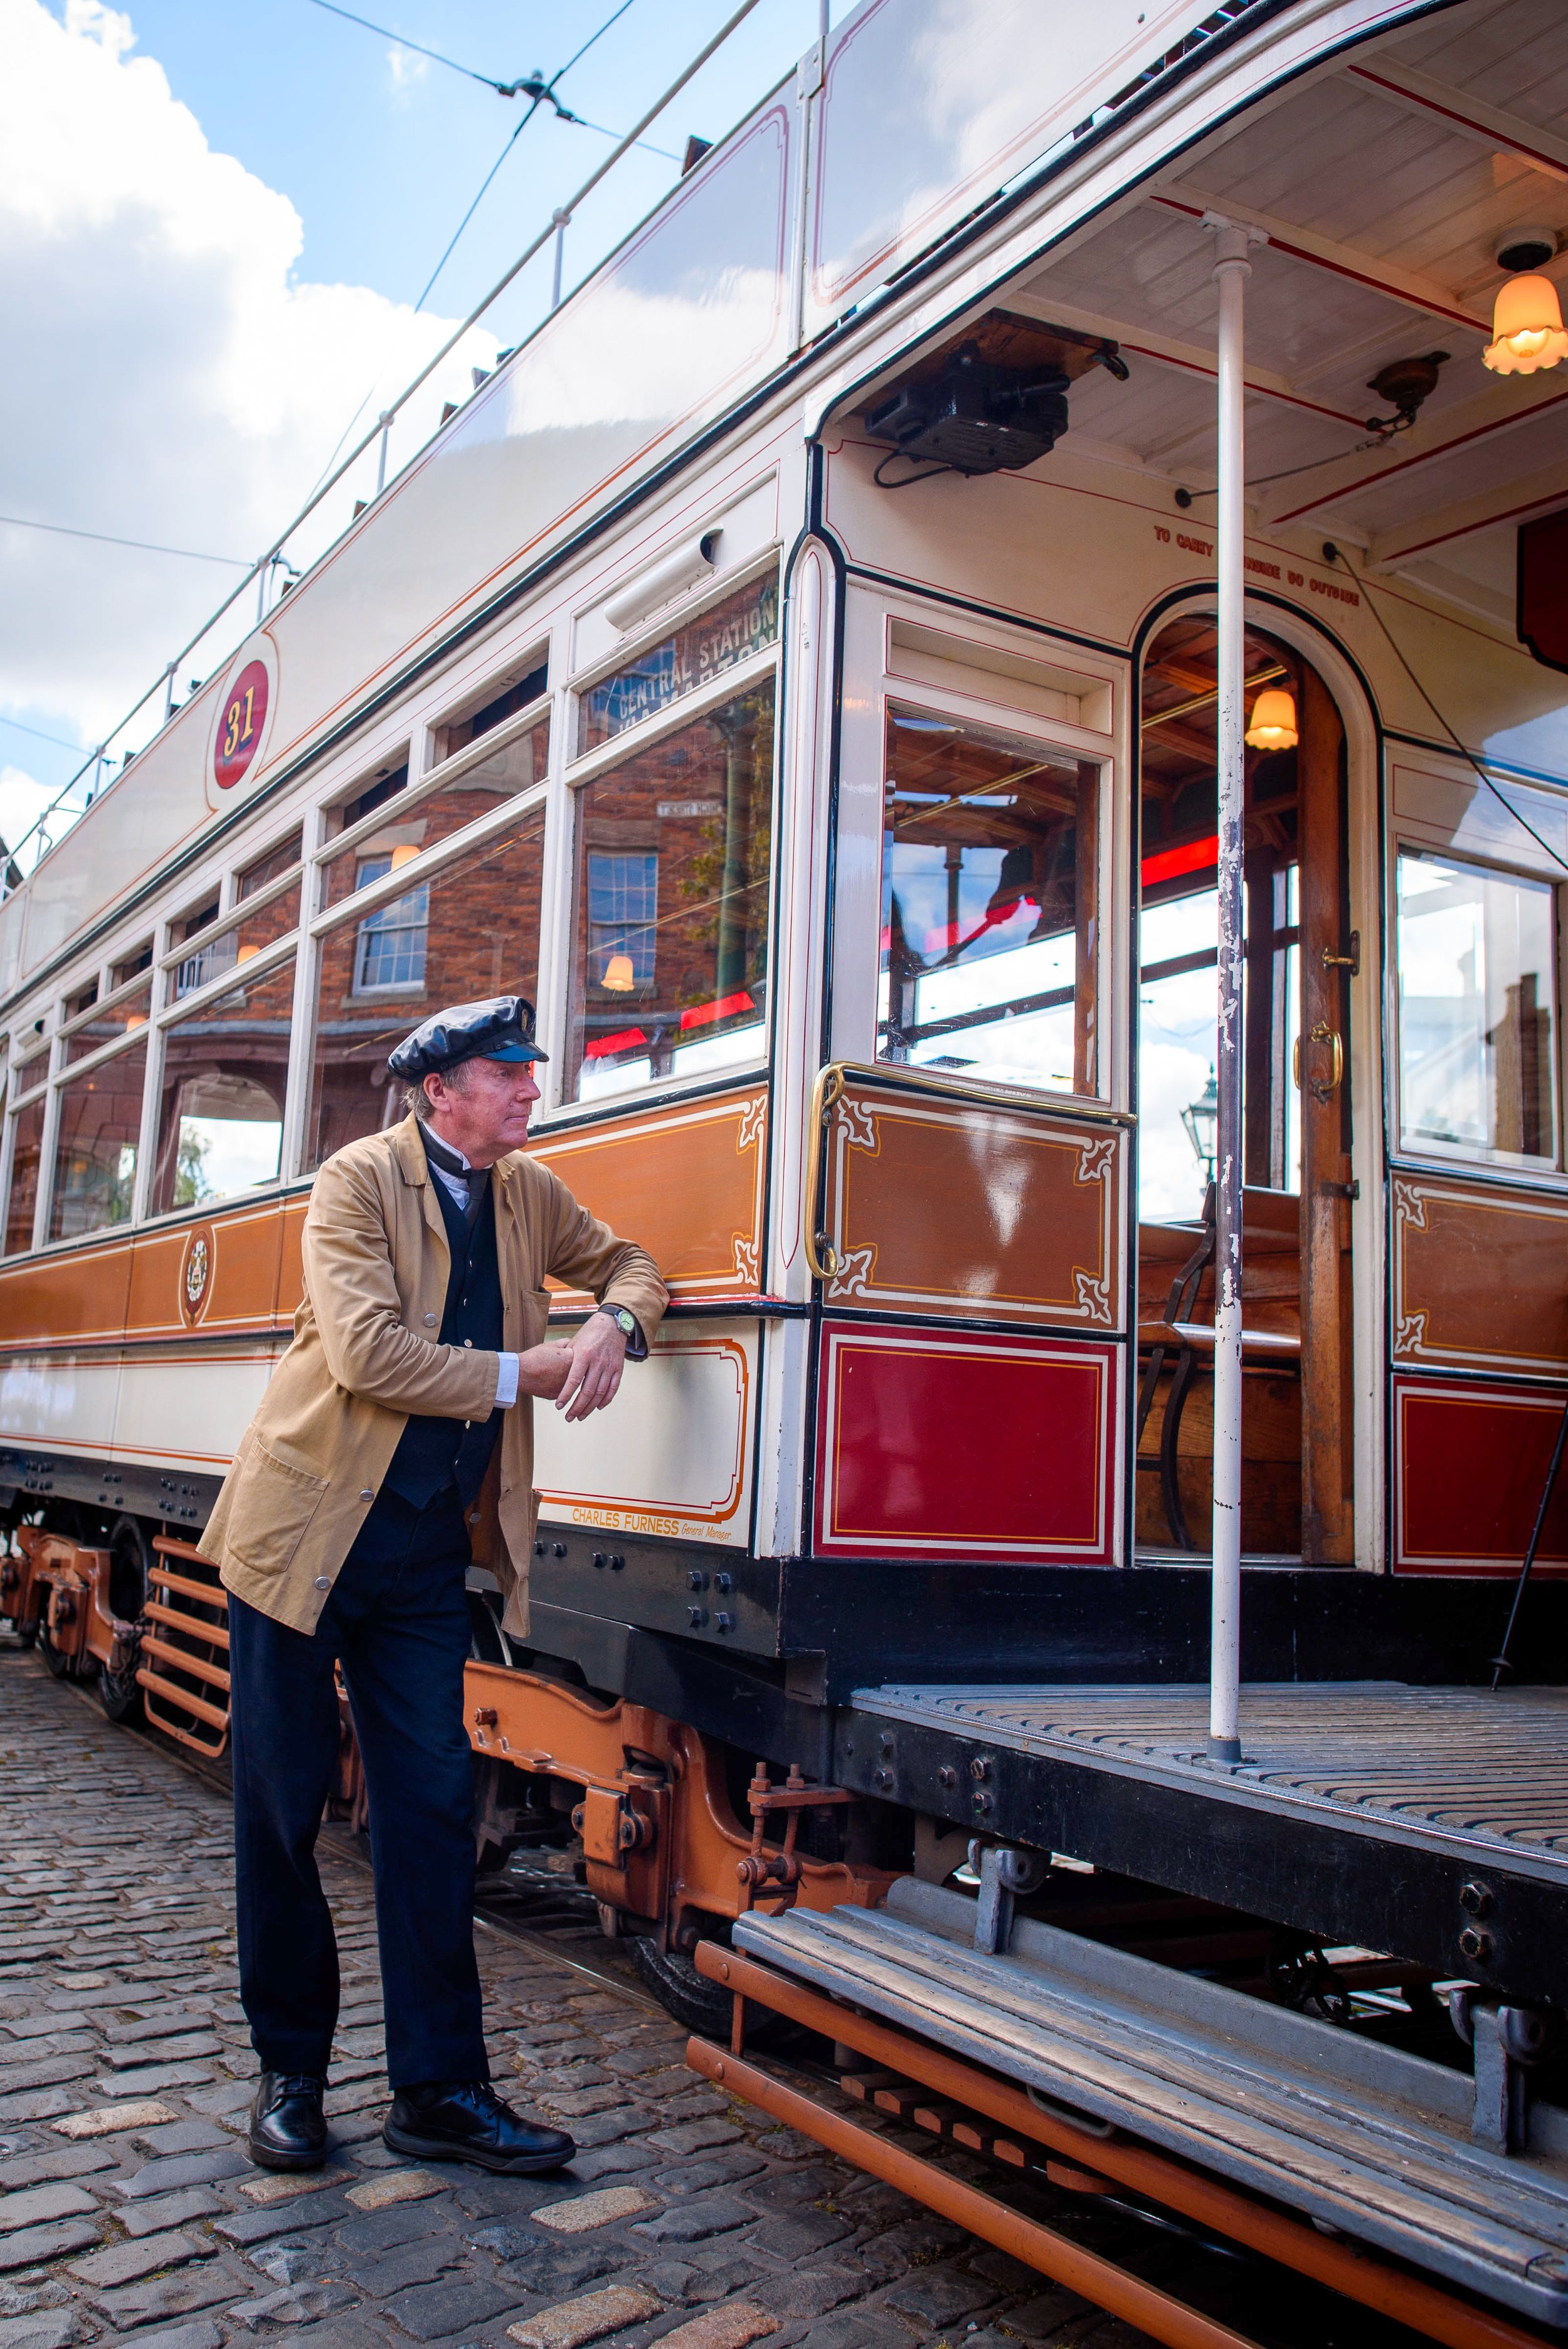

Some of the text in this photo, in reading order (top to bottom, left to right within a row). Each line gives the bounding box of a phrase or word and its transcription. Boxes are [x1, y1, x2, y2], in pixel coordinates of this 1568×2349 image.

[1154, 525, 1170, 543] TO
[1177, 533, 1214, 557] CARRY
[1244, 556, 1281, 580] INSIDE
[1310, 578, 1360, 607] OUTSIDE
[619, 656, 692, 719] CENTRAL
[700, 598, 774, 669] STATION
[224, 686, 254, 757] 31
[572, 1508, 620, 1528] CHARLES
[624, 1514, 679, 1535] FURNESS
[681, 1523, 704, 1536] General
